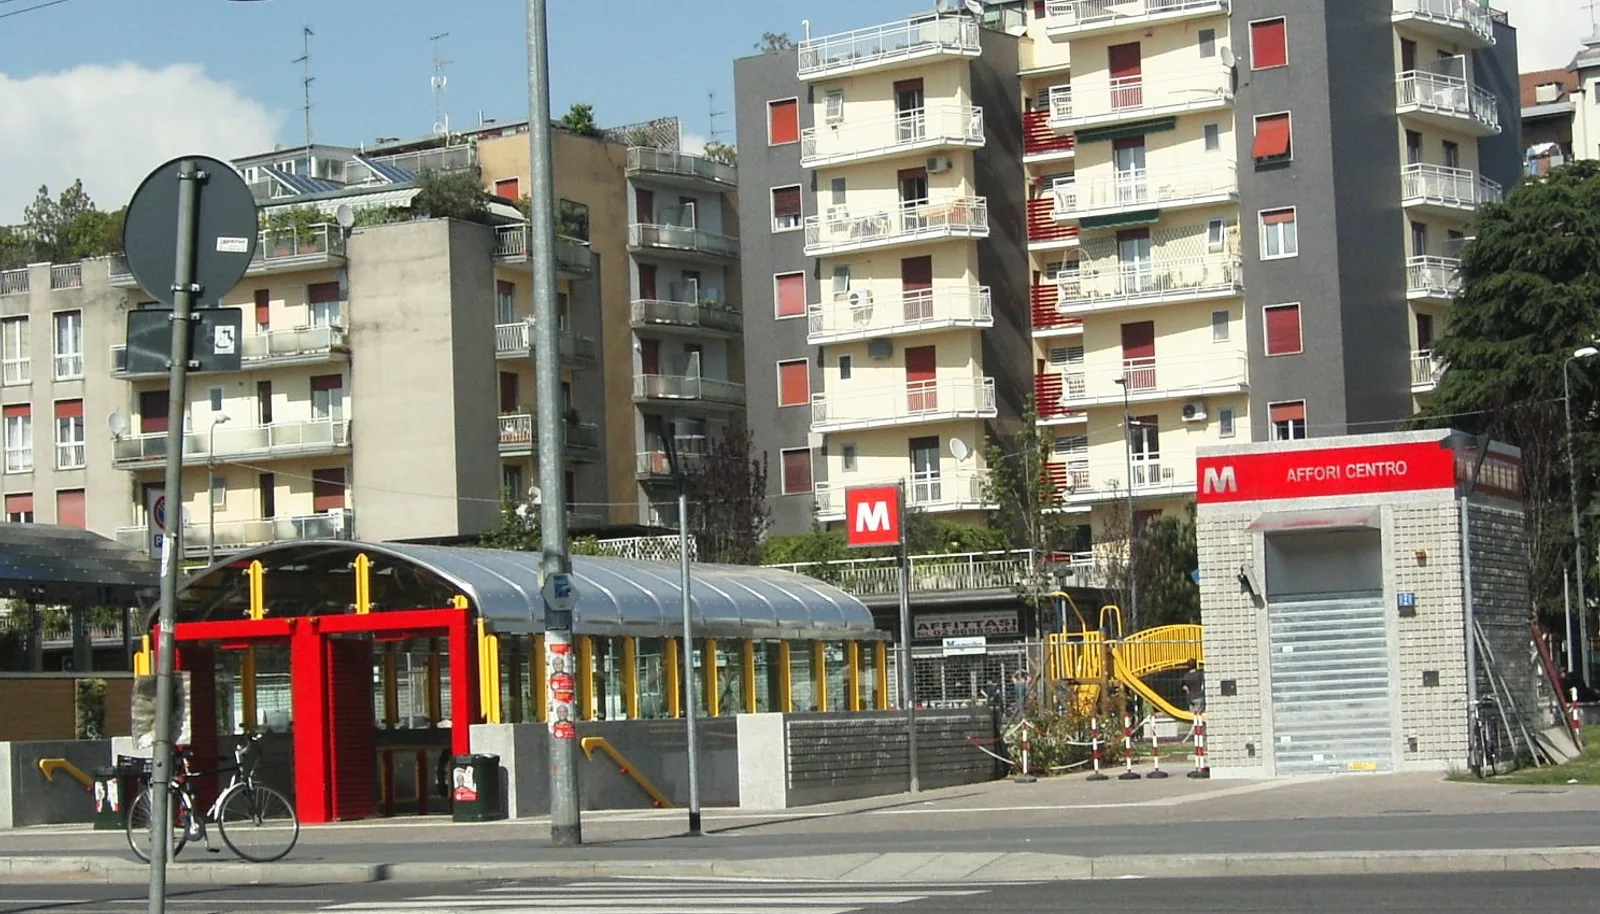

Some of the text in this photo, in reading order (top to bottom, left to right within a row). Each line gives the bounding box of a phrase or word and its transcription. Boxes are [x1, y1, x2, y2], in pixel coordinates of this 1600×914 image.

[1203, 460, 1407, 494] M AFFORI CENTRO
[856, 501, 890, 532] M
[917, 619, 1016, 630] AFFITTASI
